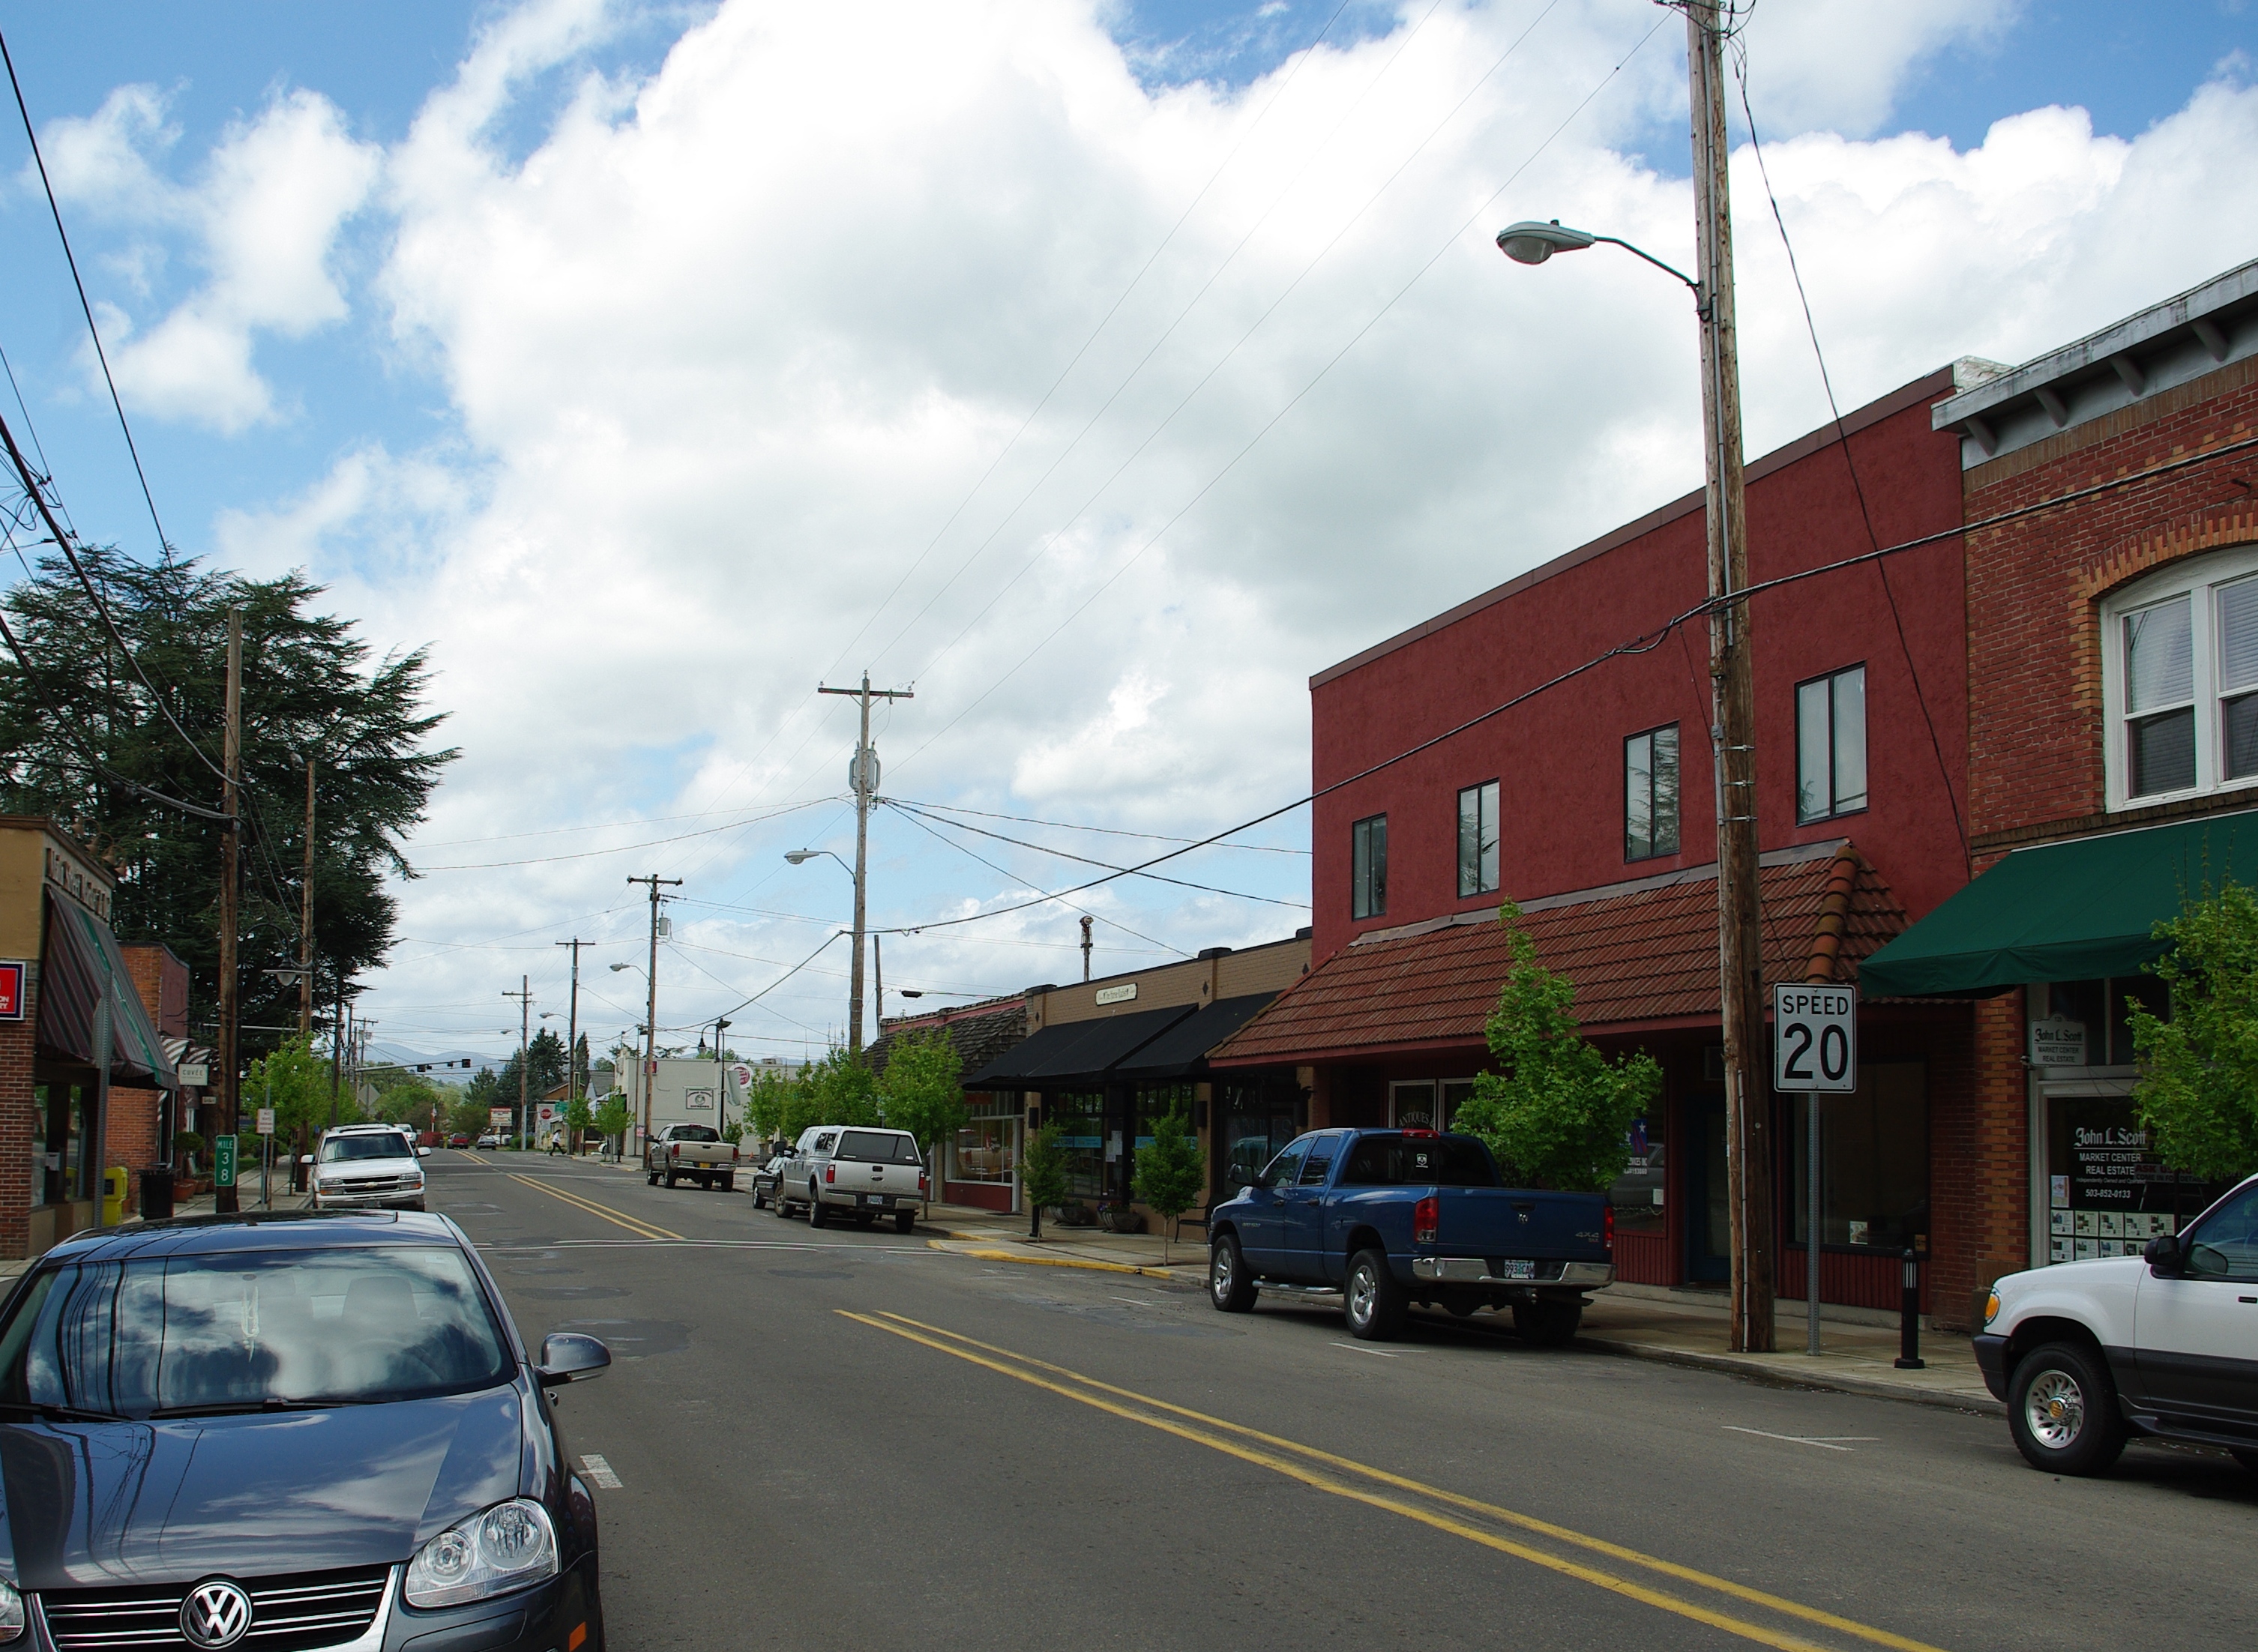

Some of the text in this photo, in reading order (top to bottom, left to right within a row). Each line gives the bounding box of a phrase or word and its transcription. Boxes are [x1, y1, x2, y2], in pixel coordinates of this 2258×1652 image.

[1783, 995, 1849, 1016] SPEED
[2035, 1028, 2054, 1042] John
[2064, 1029, 2083, 1042] Scott
[1784, 1022, 1849, 1081] 20
[1399, 1111, 1430, 1128] ANTIQUES
[2073, 1127, 2147, 1148] John L. Scott
[217, 1140, 233, 1149] MILE
[221, 1152, 229, 1165] 3
[2079, 1152, 2142, 1163] MARKET CENTER
[221, 1169, 229, 1181] 8
[2086, 1165, 2135, 1176] REAL ESTATE
[2137, 1165, 2156, 1173] ASK
[2085, 1189, 2131, 1199] 503-852-0133
[1505, 1264, 1518, 1274] 993
